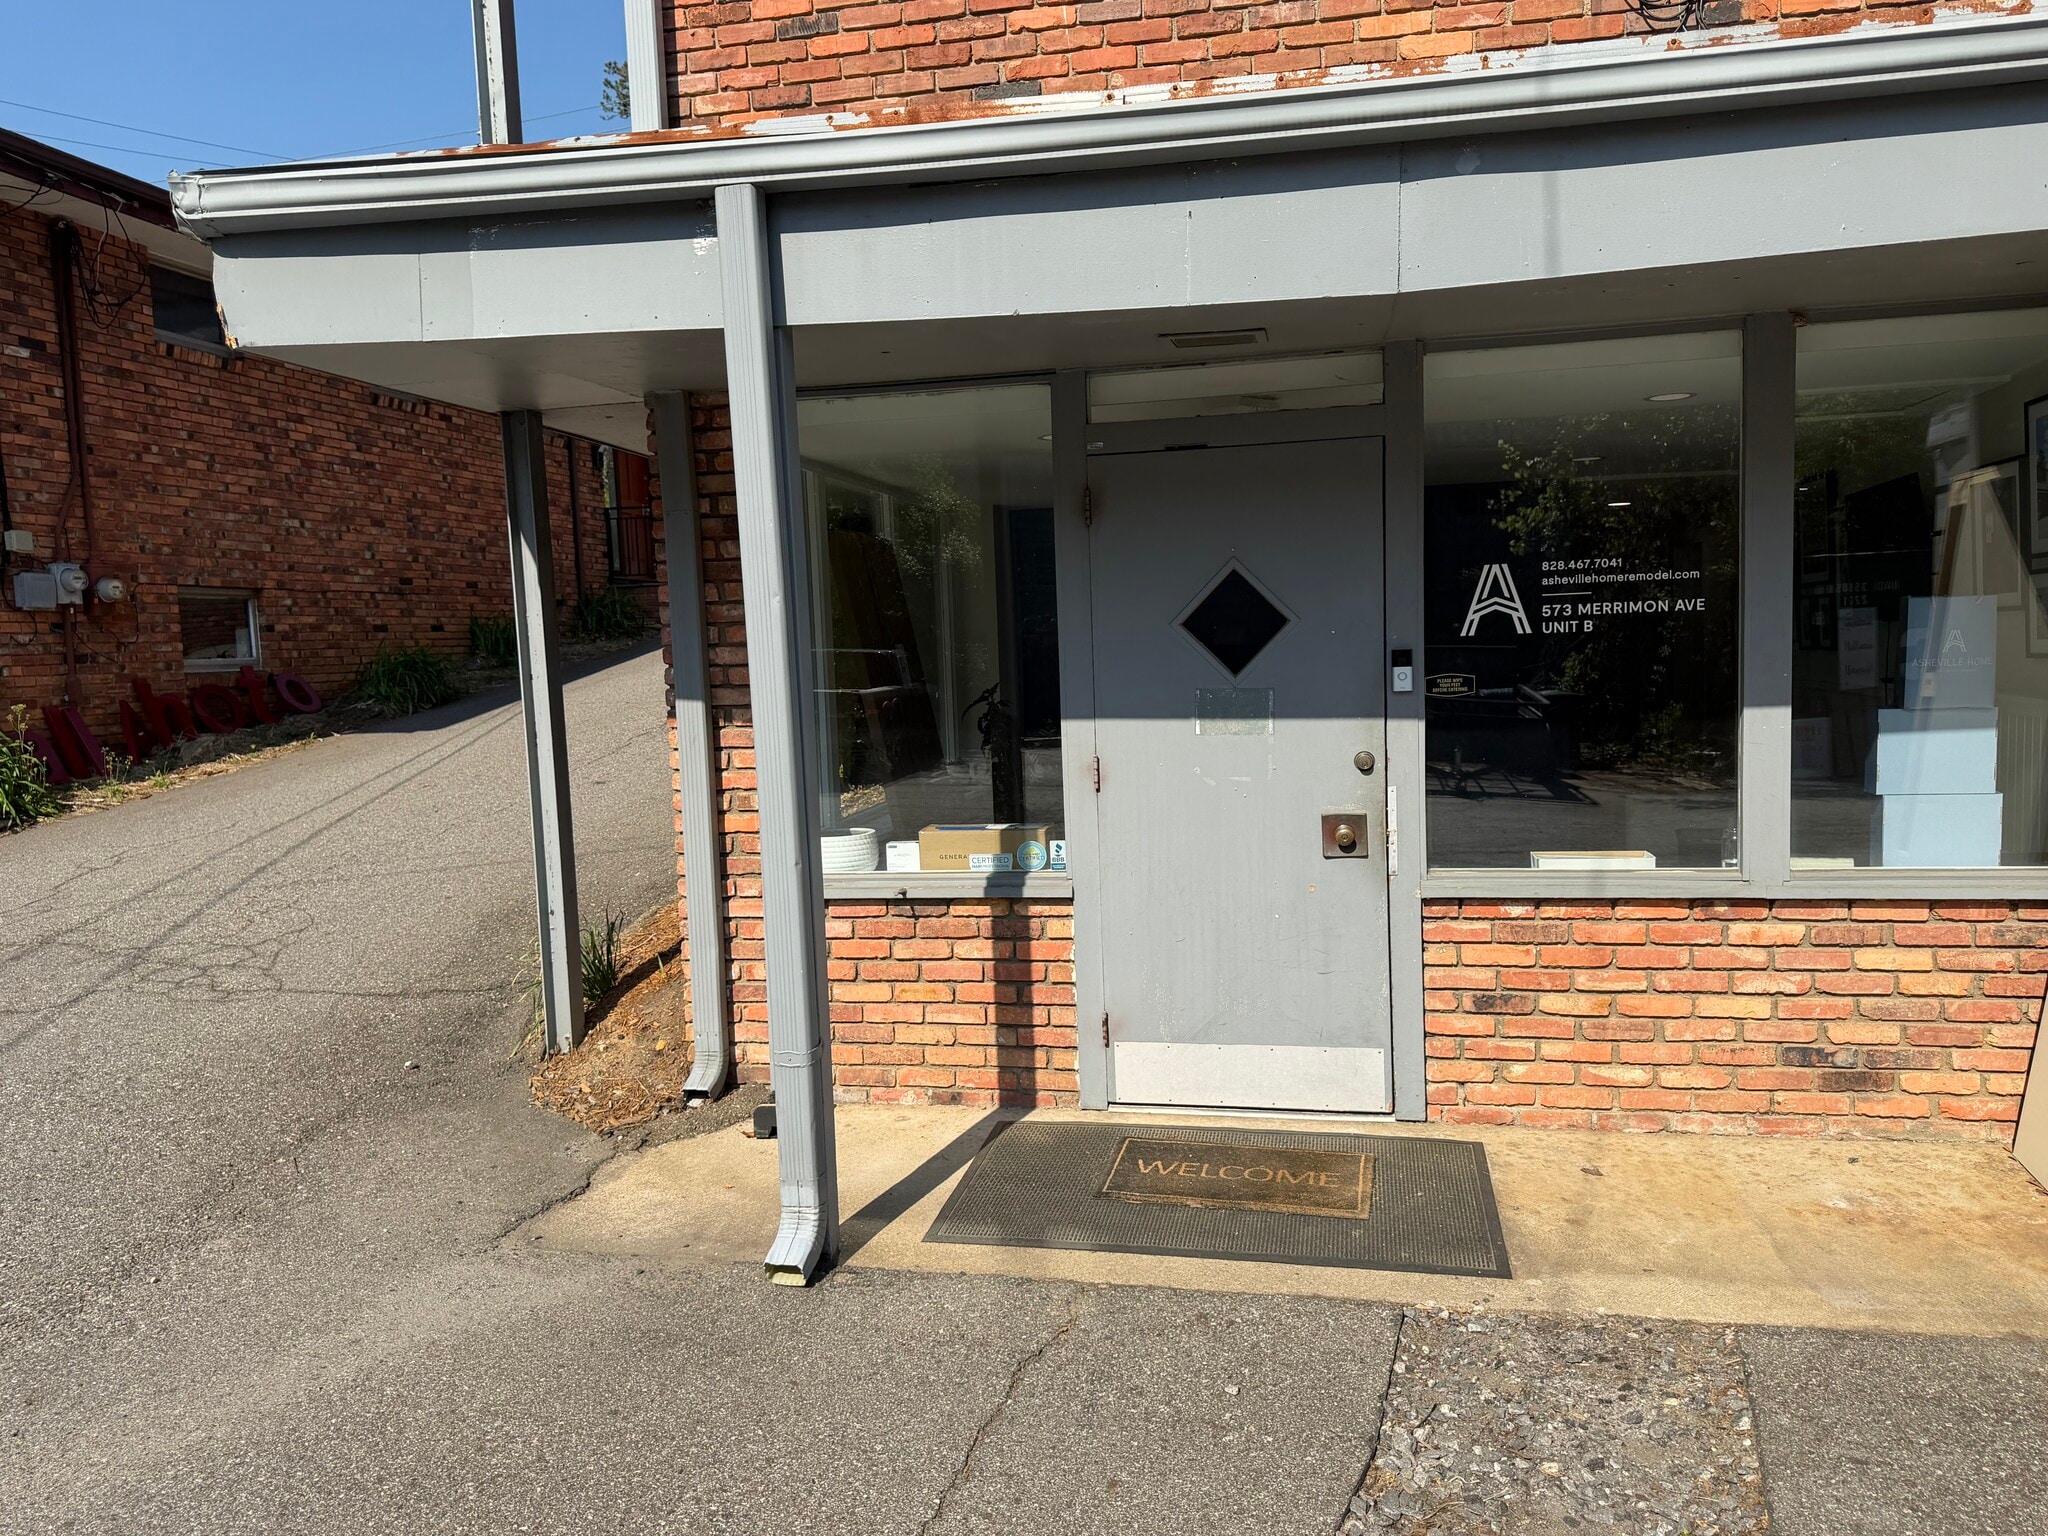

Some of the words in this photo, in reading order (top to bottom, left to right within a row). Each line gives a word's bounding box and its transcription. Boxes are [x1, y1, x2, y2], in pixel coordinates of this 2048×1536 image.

[1541, 558, 1623, 571] 828.467.7041
[1541, 569, 1701, 586] ashevillehomeremodel.com
[1541, 604, 1573, 617] 573
[1578, 600, 1670, 616] MERRIMON
[1674, 598, 1706, 612] AVE
[1541, 621, 1580, 634] UNIT
[1583, 620, 1594, 632] B
[1911, 657, 1965, 667] ASHEVILLE
[1967, 656, 1993, 666] HOME
[971, 856, 1010, 864] CERTIFIED
[1136, 1158, 1342, 1188] WELCOME
